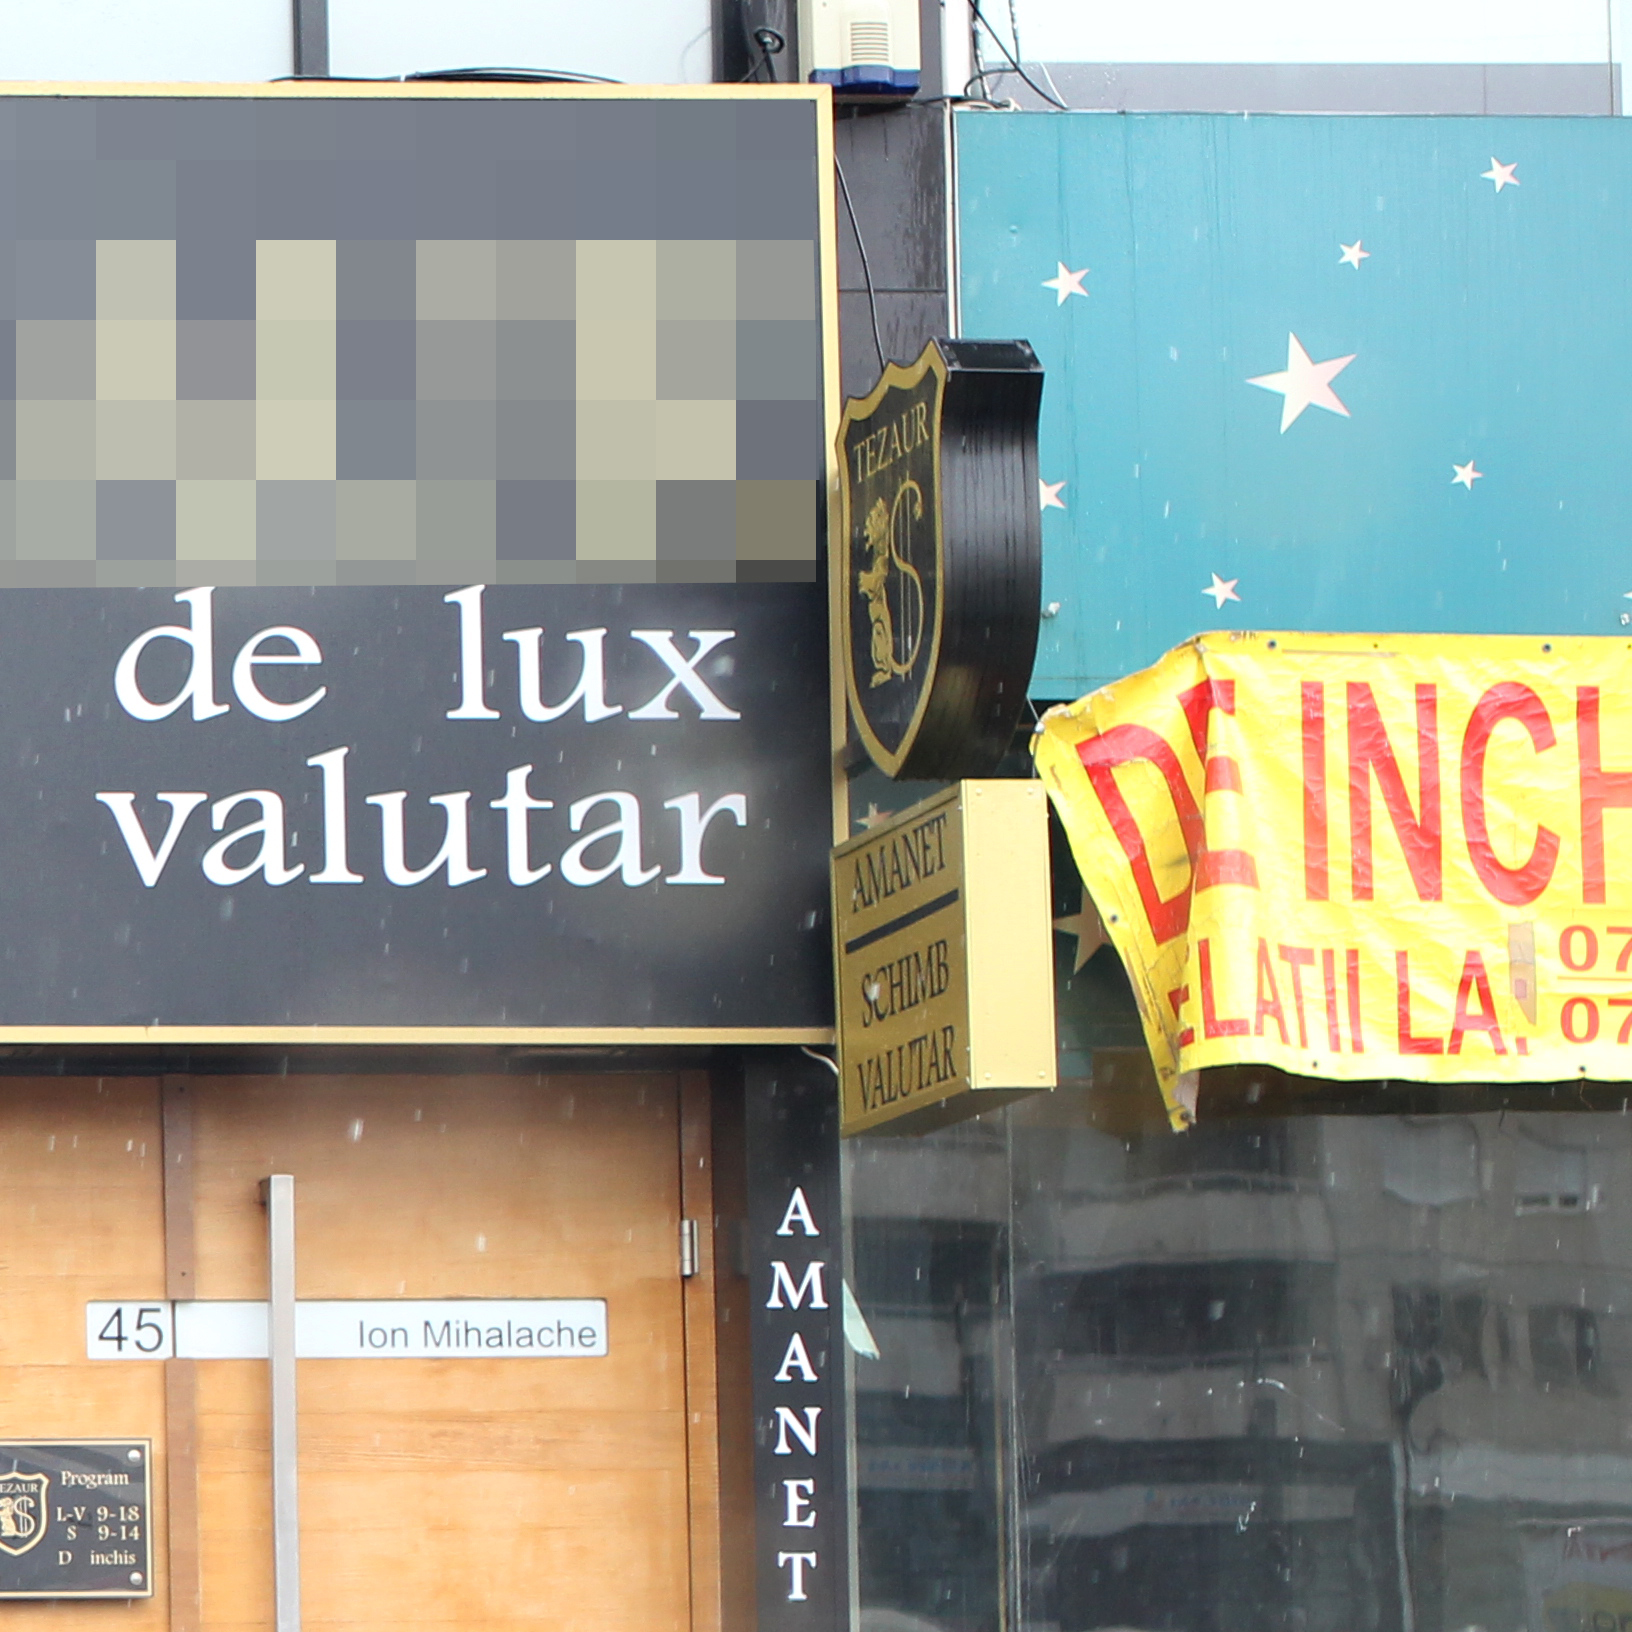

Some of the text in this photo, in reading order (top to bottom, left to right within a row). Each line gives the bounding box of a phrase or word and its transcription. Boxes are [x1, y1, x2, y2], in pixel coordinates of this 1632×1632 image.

[853, 400, 931, 487] TEZAUR
[113, 585, 327, 722] de
[443, 583, 742, 722] lux
[94, 747, 748, 888] valutar
[1076, 678, 1260, 947] DE
[851, 812, 948, 916] AMANET
[860, 938, 951, 1030] SCHIMB
[856, 1026, 957, 1115] VALUTAR
[97, 1307, 164, 1353] 45
[359, 1319, 598, 1350] Ion Mihalache
[765, 1186, 829, 1602] AMANET
[56, 1505, 141, 1522] L-V 9-18
[60, 1470, 130, 1490] Program
[58, 1550, 137, 1566] D inchis
[66, 1525, 141, 1541] S 9-14
